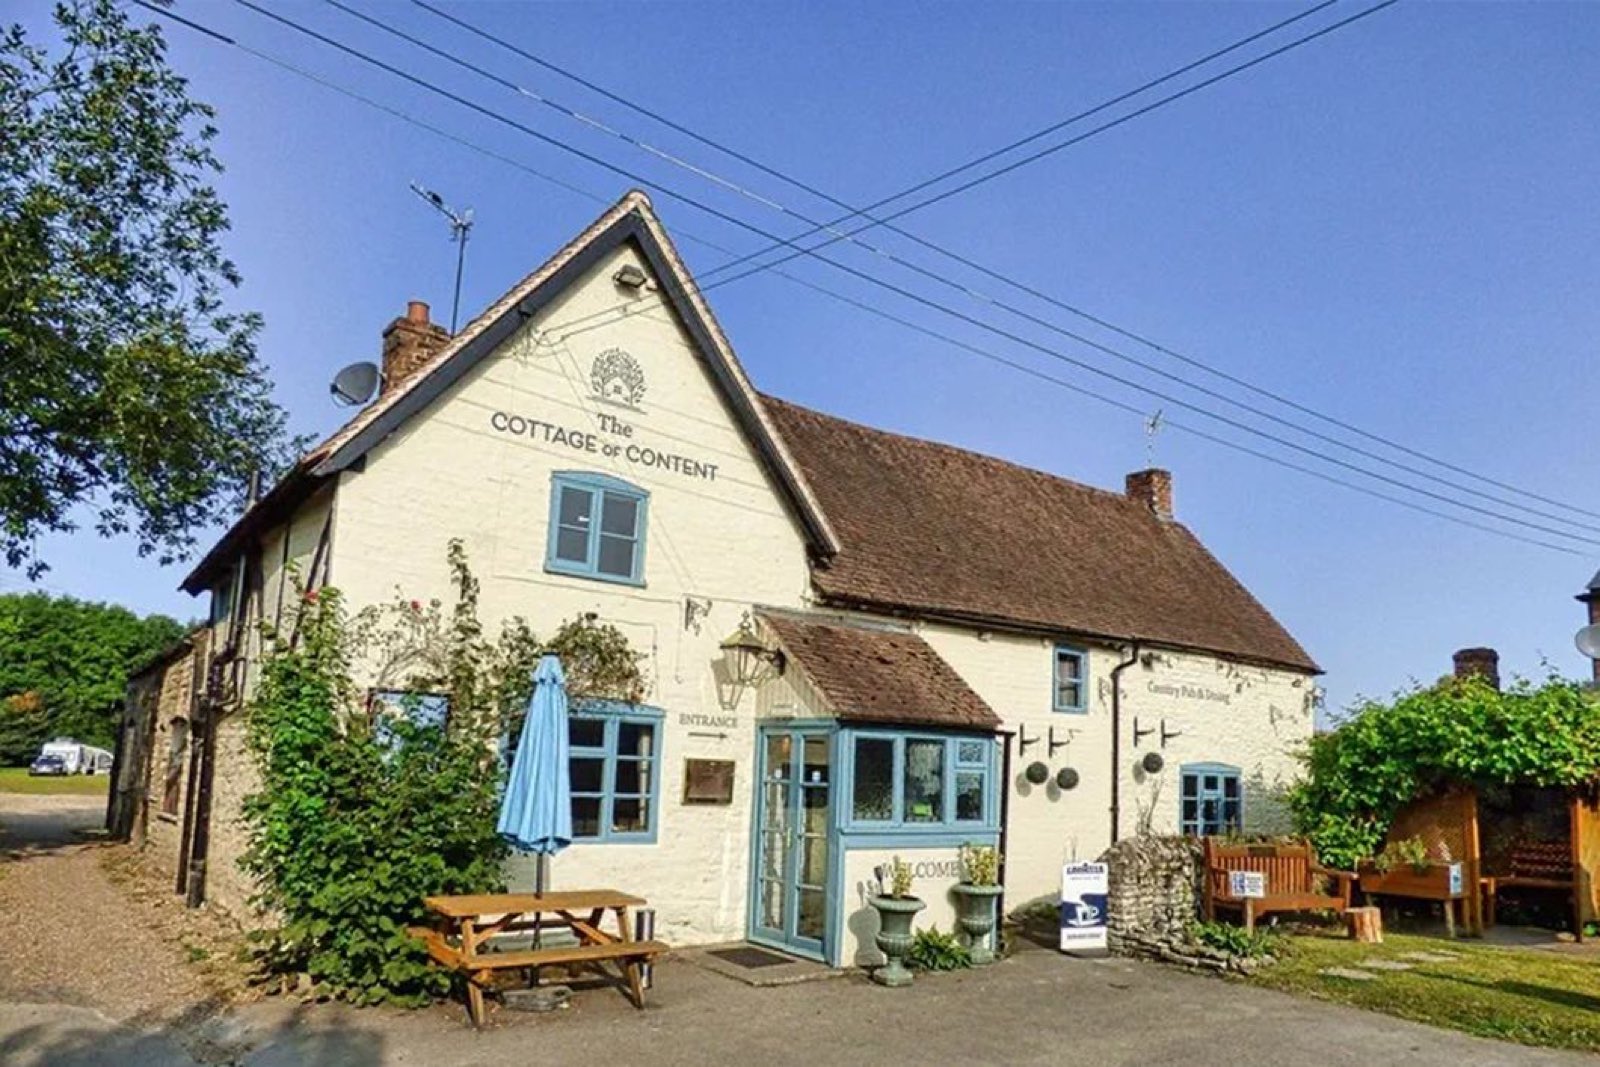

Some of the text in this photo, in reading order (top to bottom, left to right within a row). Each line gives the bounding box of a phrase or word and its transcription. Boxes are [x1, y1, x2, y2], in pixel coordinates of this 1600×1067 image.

[597, 412, 633, 438] The
[491, 411, 597, 453] COTTAGE
[626, 443, 719, 481] CONTENT
[679, 713, 738, 729] ENTRANCE
